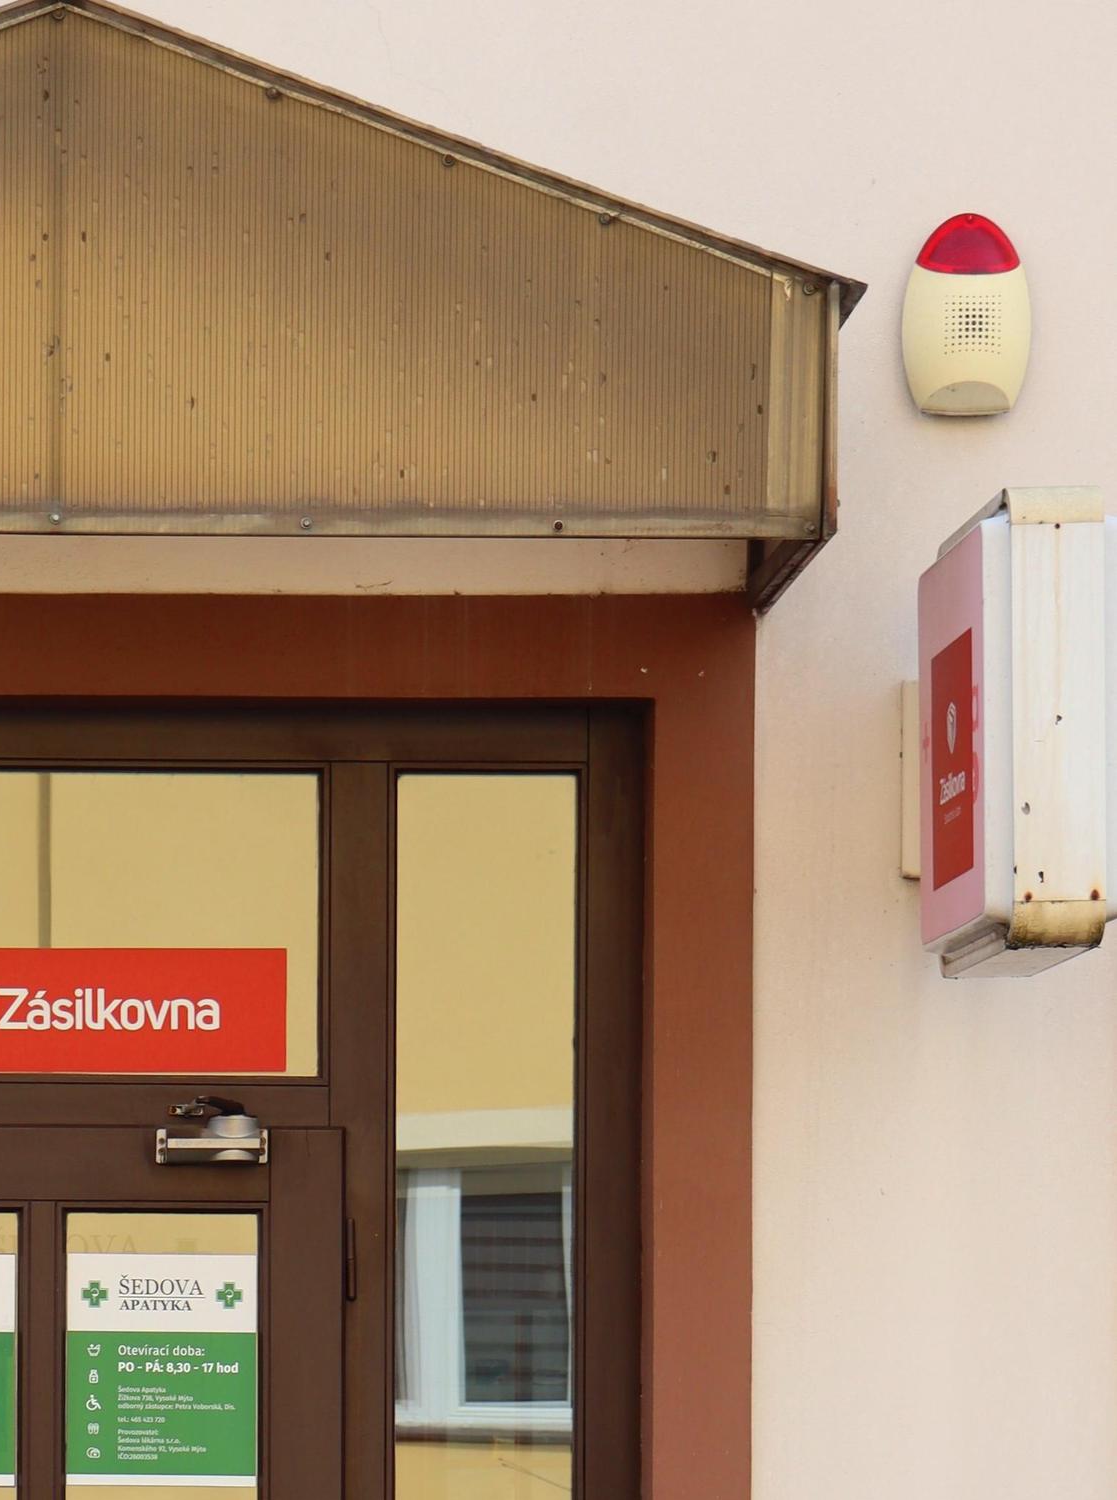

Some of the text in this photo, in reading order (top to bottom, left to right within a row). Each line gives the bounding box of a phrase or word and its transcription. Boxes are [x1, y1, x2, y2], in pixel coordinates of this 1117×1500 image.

[118, 1274, 204, 1296] ŠEDOVA
[119, 1299, 193, 1311] APATYKA
[118, 1344, 205, 1356] Otevírací doba:
[118, 1362, 135, 1373] PO
[145, 1359, 164, 1373] PÁ:
[166, 1363, 191, 1375] 8,30
[202, 1363, 214, 1373] 17
[216, 1363, 239, 1374] hod
